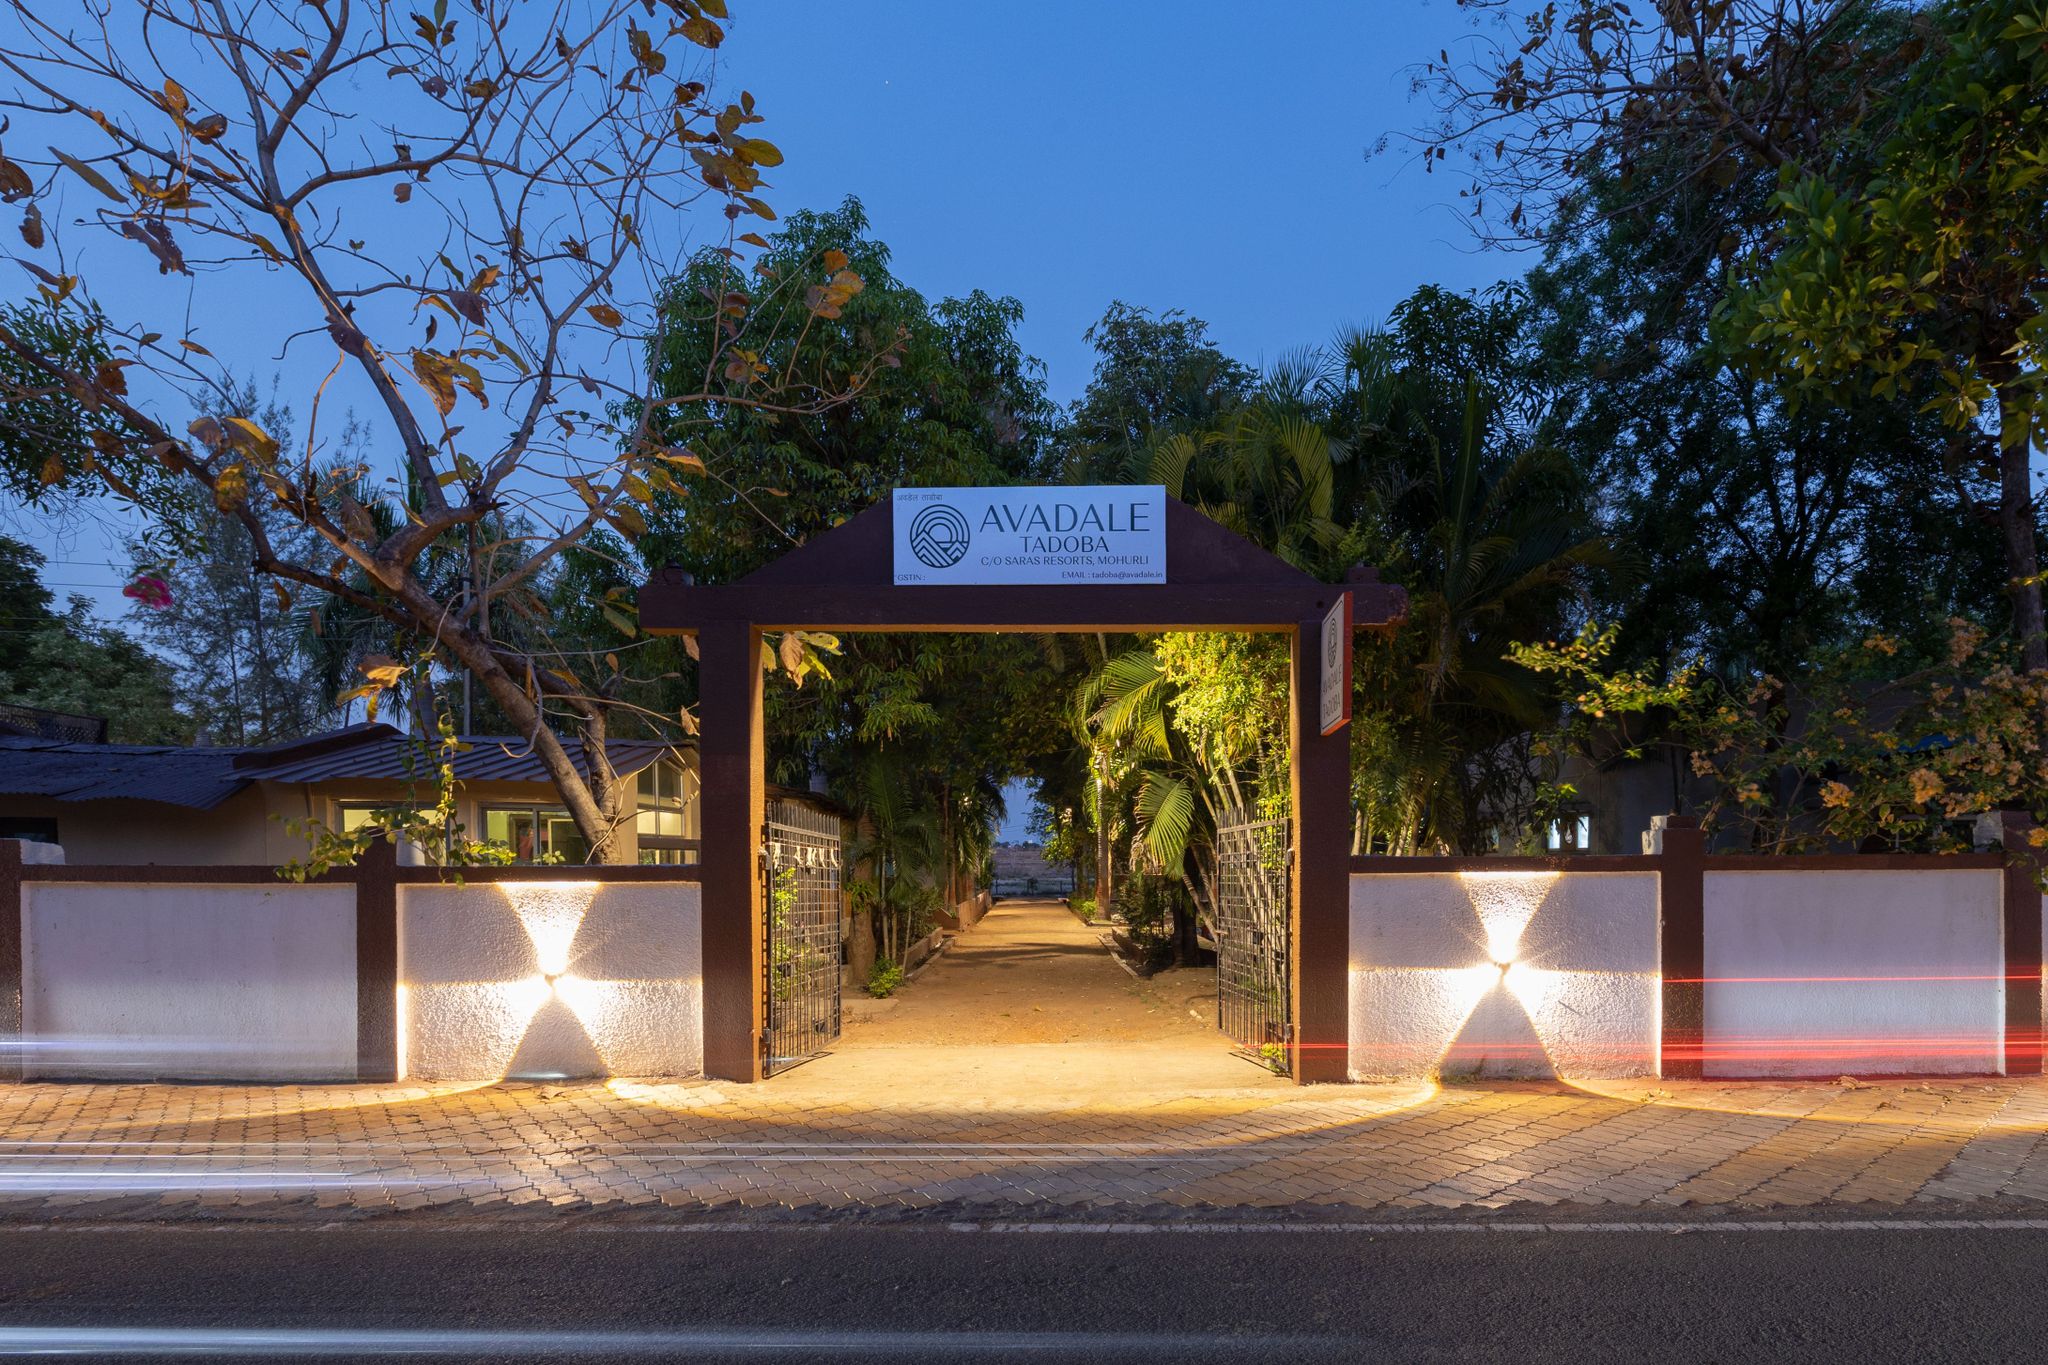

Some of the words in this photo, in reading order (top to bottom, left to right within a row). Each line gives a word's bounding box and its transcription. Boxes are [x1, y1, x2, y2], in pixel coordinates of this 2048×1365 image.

[979, 502, 1151, 533] AVADALE
[1019, 535, 1110, 553] TADOBA
[980, 556, 1002, 567] C/O
[1004, 556, 1041, 566] SARAS
[1043, 556, 1096, 567] RESORTS,
[1097, 555, 1149, 565] MOHURLI
[1091, 570, 1163, 579] tadoba@avadale.in
